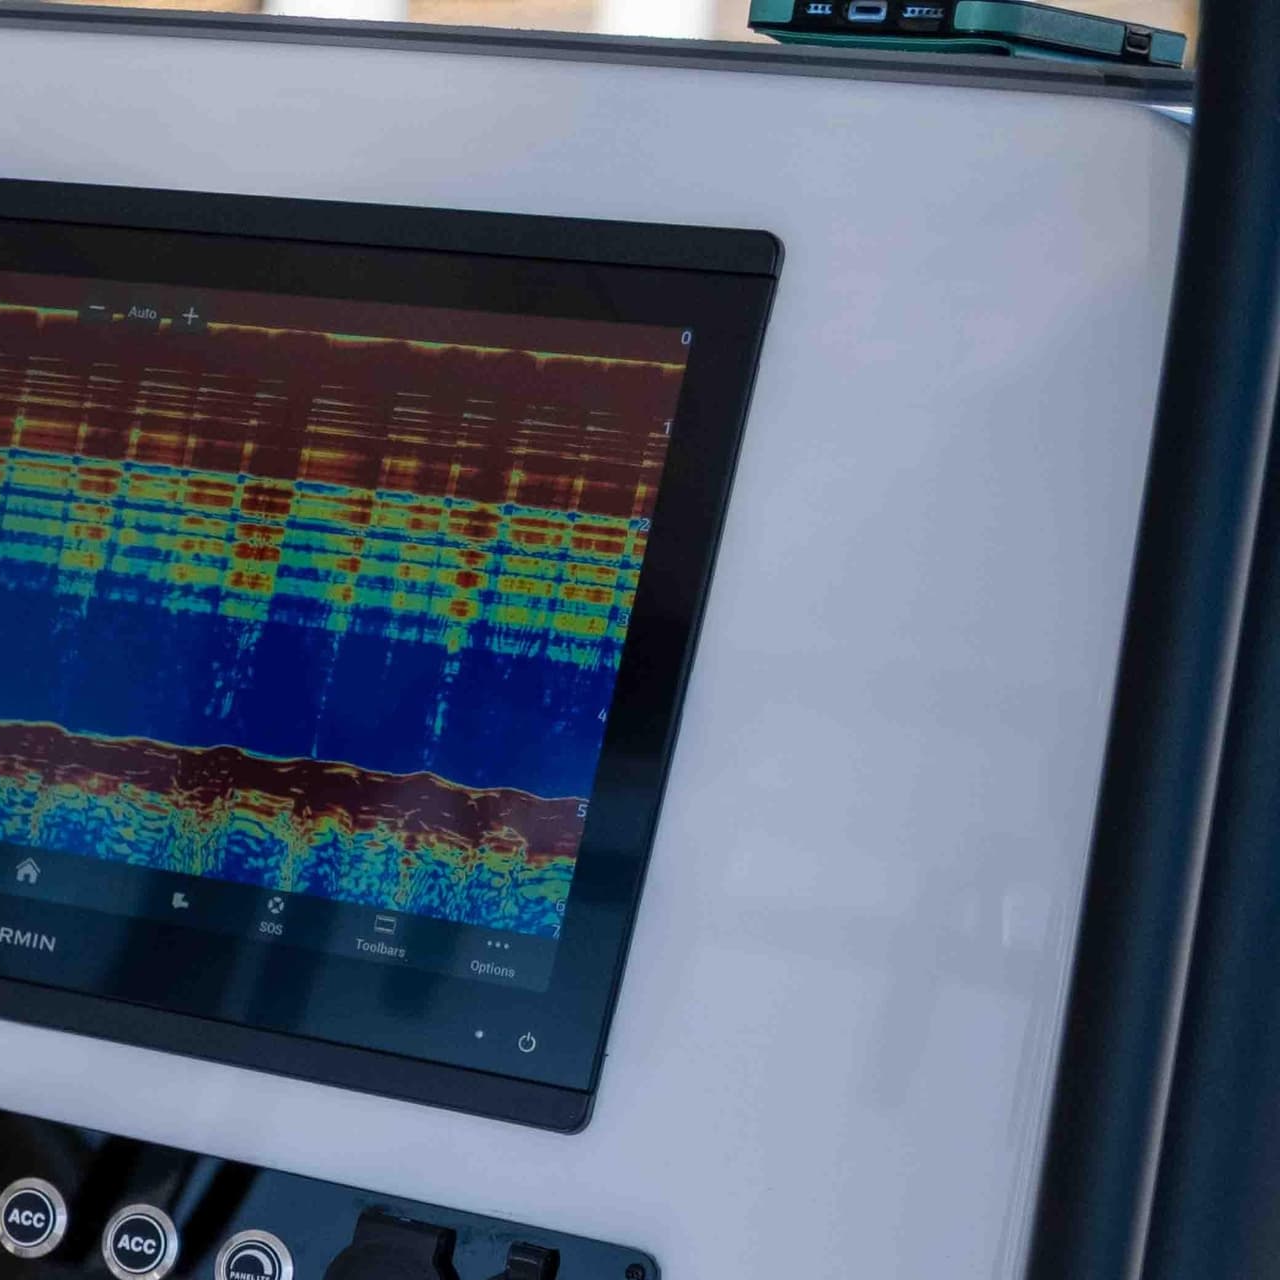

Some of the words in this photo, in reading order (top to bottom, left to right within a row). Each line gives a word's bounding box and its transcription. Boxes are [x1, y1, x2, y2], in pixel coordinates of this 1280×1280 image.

[127, 305, 157, 320] Auto
[680, 330, 693, 346] 0
[597, 706, 608, 723] 4
[258, 920, 284, 936] SOS
[355, 938, 406, 958] Toolbars
[470, 960, 516, 979] Options
[7, 1208, 46, 1229] ACC
[117, 1234, 156, 1255] ACC
